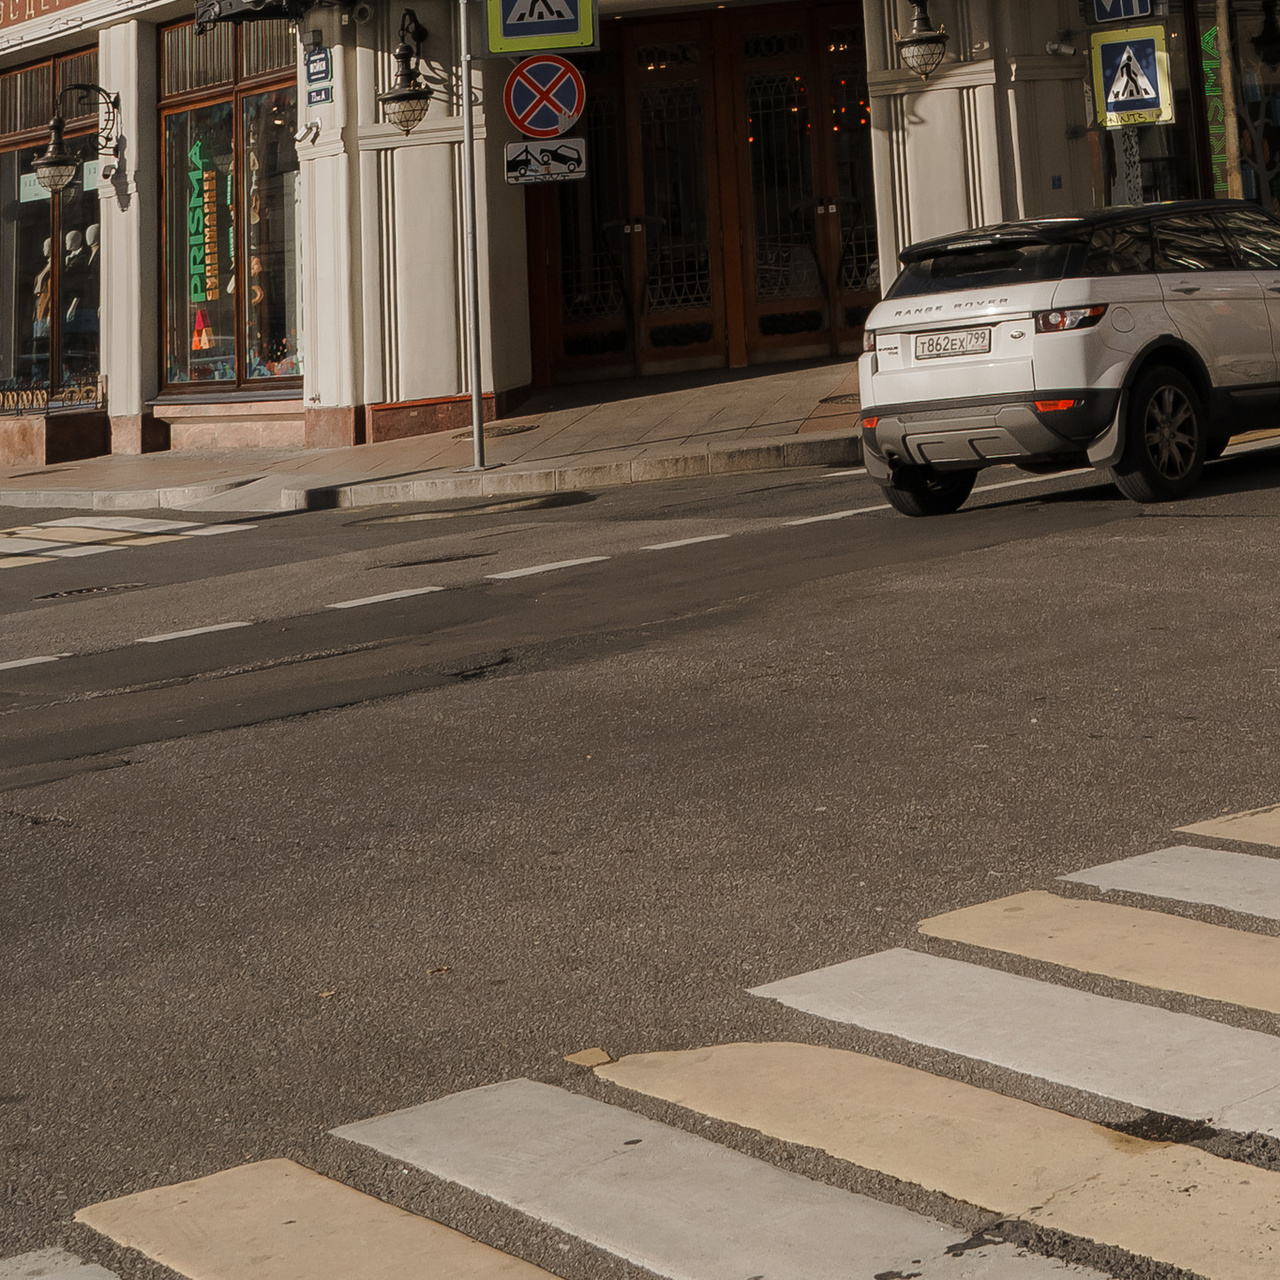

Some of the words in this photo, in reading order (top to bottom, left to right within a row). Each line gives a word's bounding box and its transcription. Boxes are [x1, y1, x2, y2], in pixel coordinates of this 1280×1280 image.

[188, 139, 209, 303] PRISMA
[203, 170, 217, 301] СУПЕРМАРКЕТ
[894, 305, 943, 317] RANGE
[953, 297, 1009, 309] ROVER
[967, 331, 986, 345] 799
